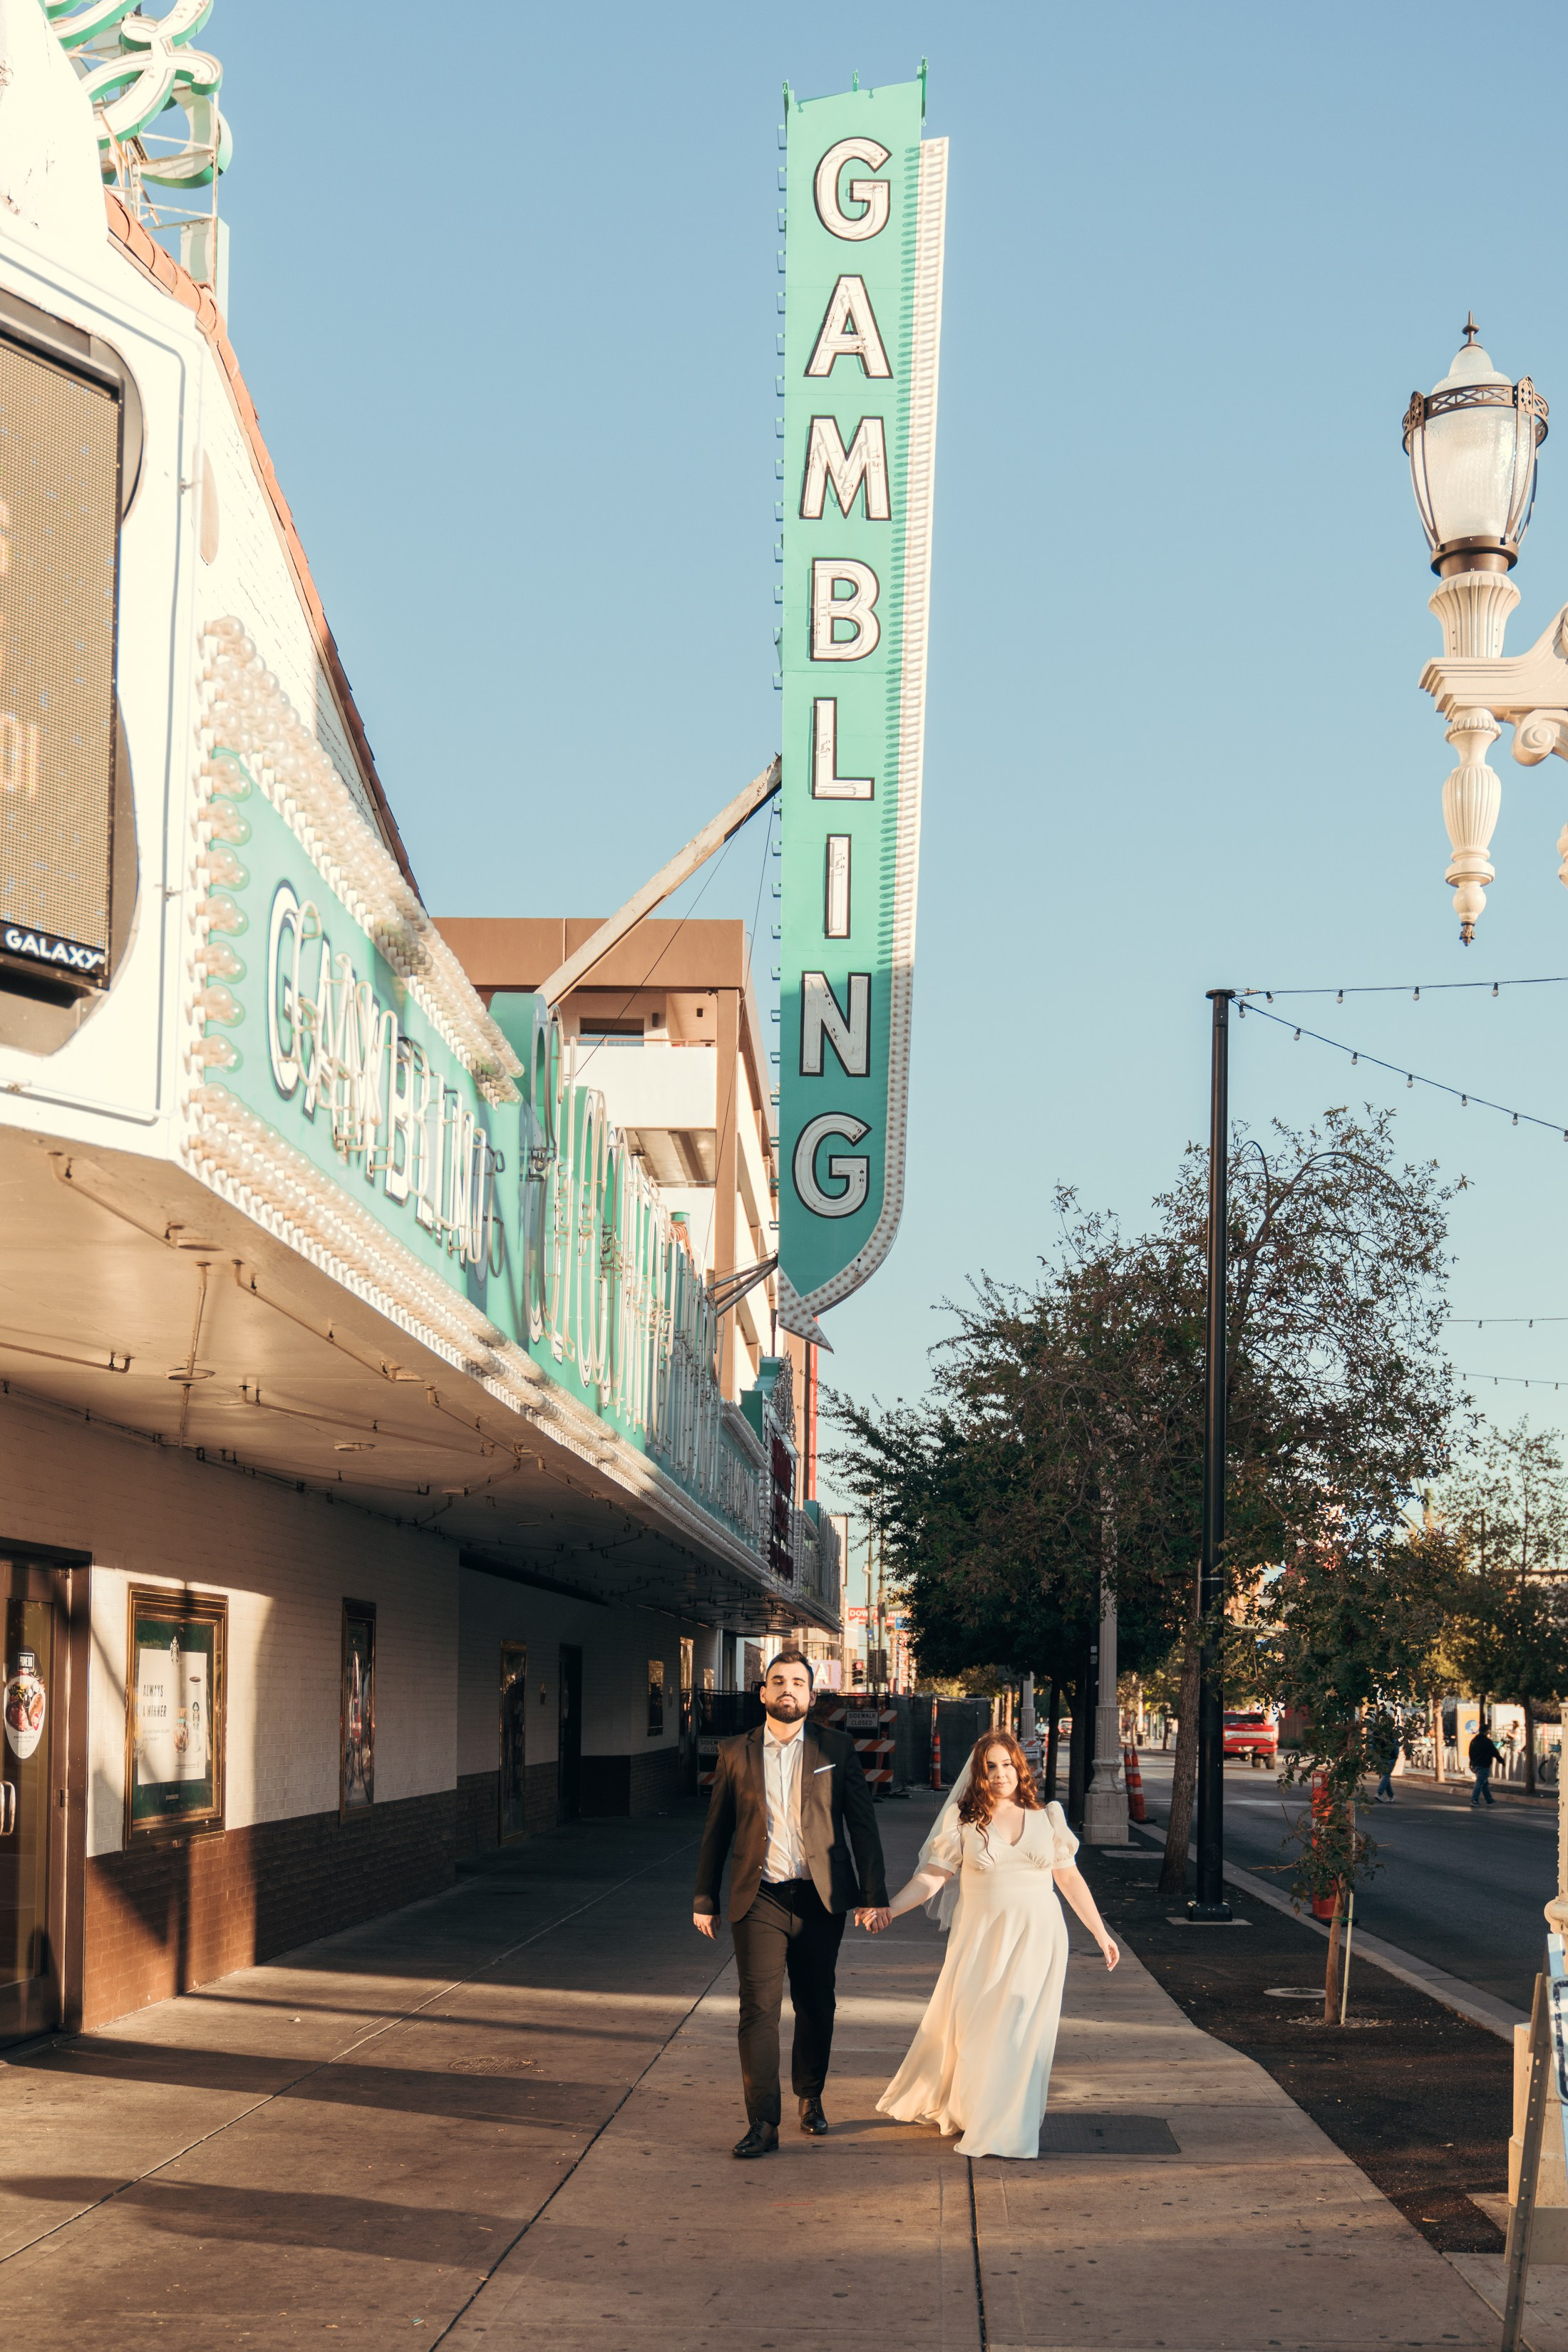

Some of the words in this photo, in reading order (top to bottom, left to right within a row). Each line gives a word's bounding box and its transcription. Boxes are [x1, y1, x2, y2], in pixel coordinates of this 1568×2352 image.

[792, 136, 894, 1218] GAMBLING
[4, 928, 100, 969] GALAXY
[143, 1684, 163, 1697] ALWAYS
[148, 1706, 167, 1717] WINNER
